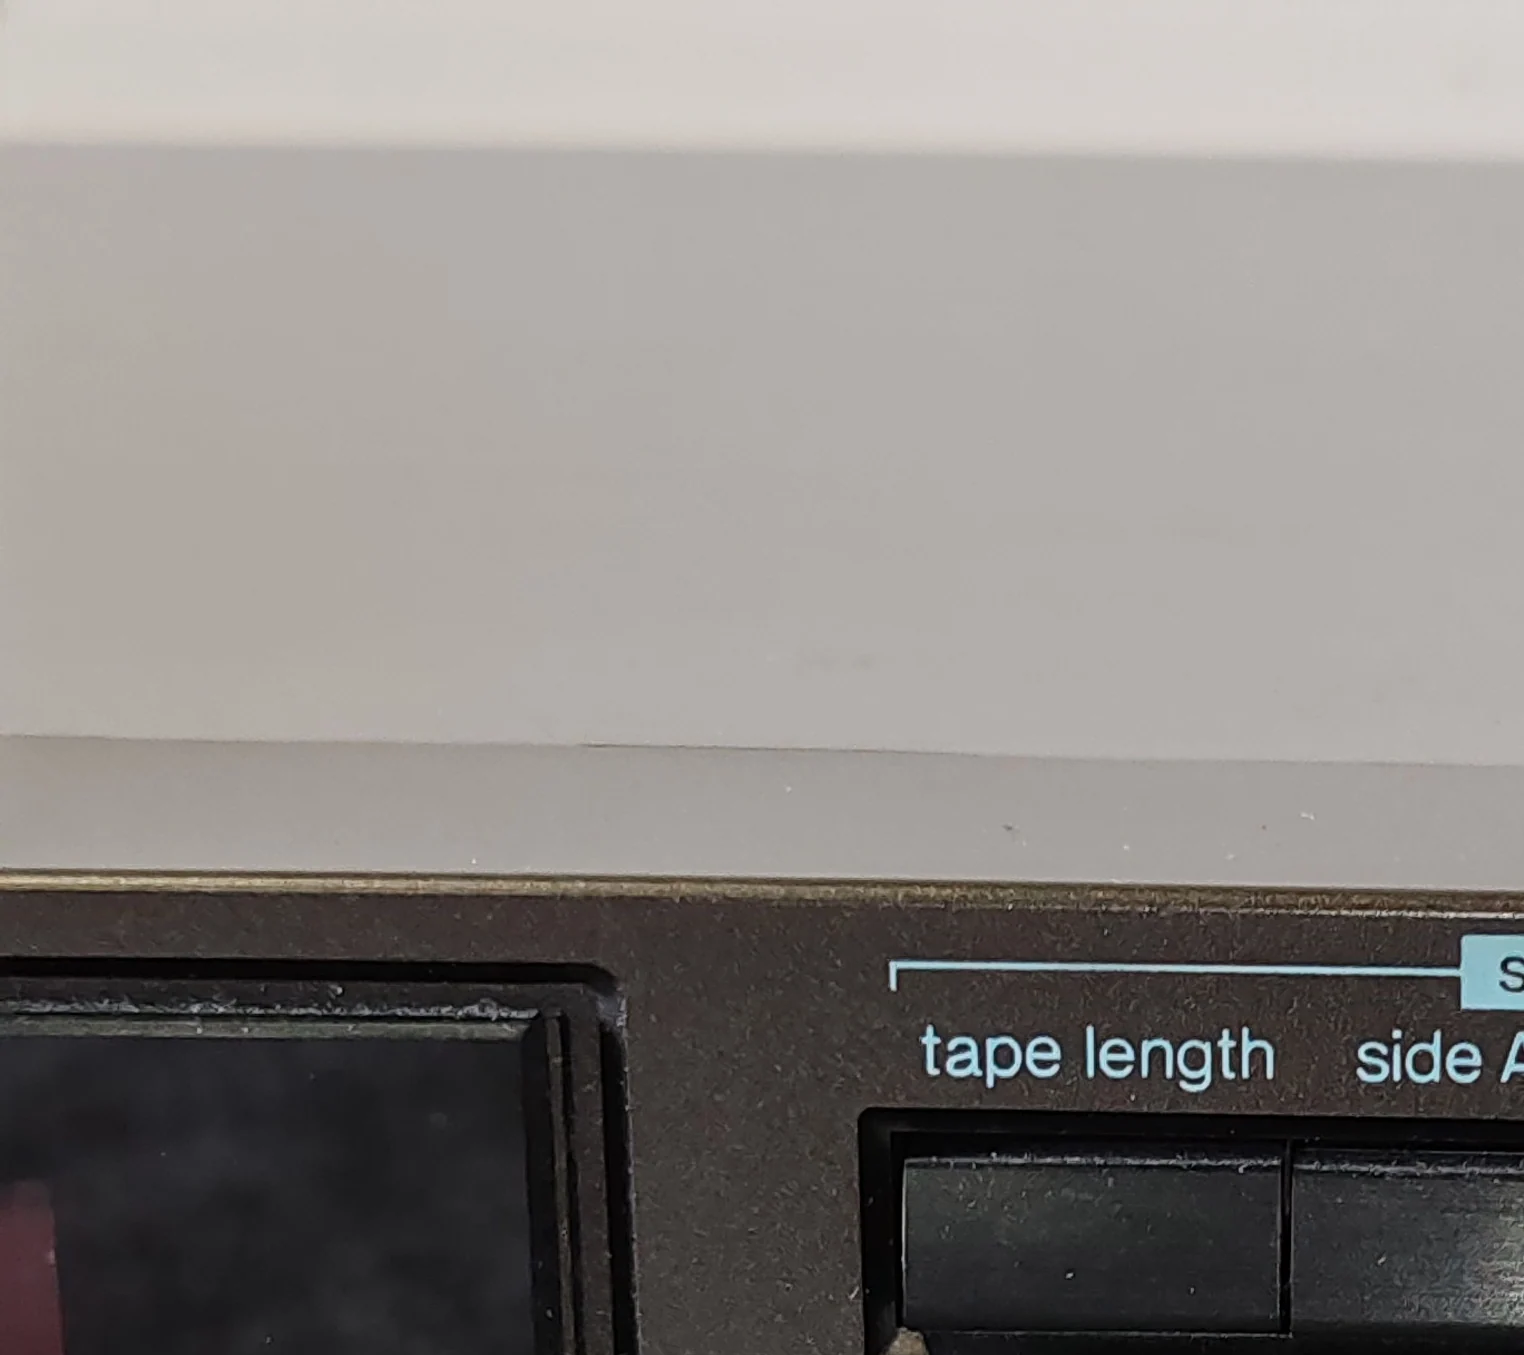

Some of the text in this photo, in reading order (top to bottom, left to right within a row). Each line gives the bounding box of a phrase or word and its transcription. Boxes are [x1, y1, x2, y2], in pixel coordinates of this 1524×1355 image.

[920, 1024, 1274, 1093] tape length
[1356, 1029, 1482, 1084] side
